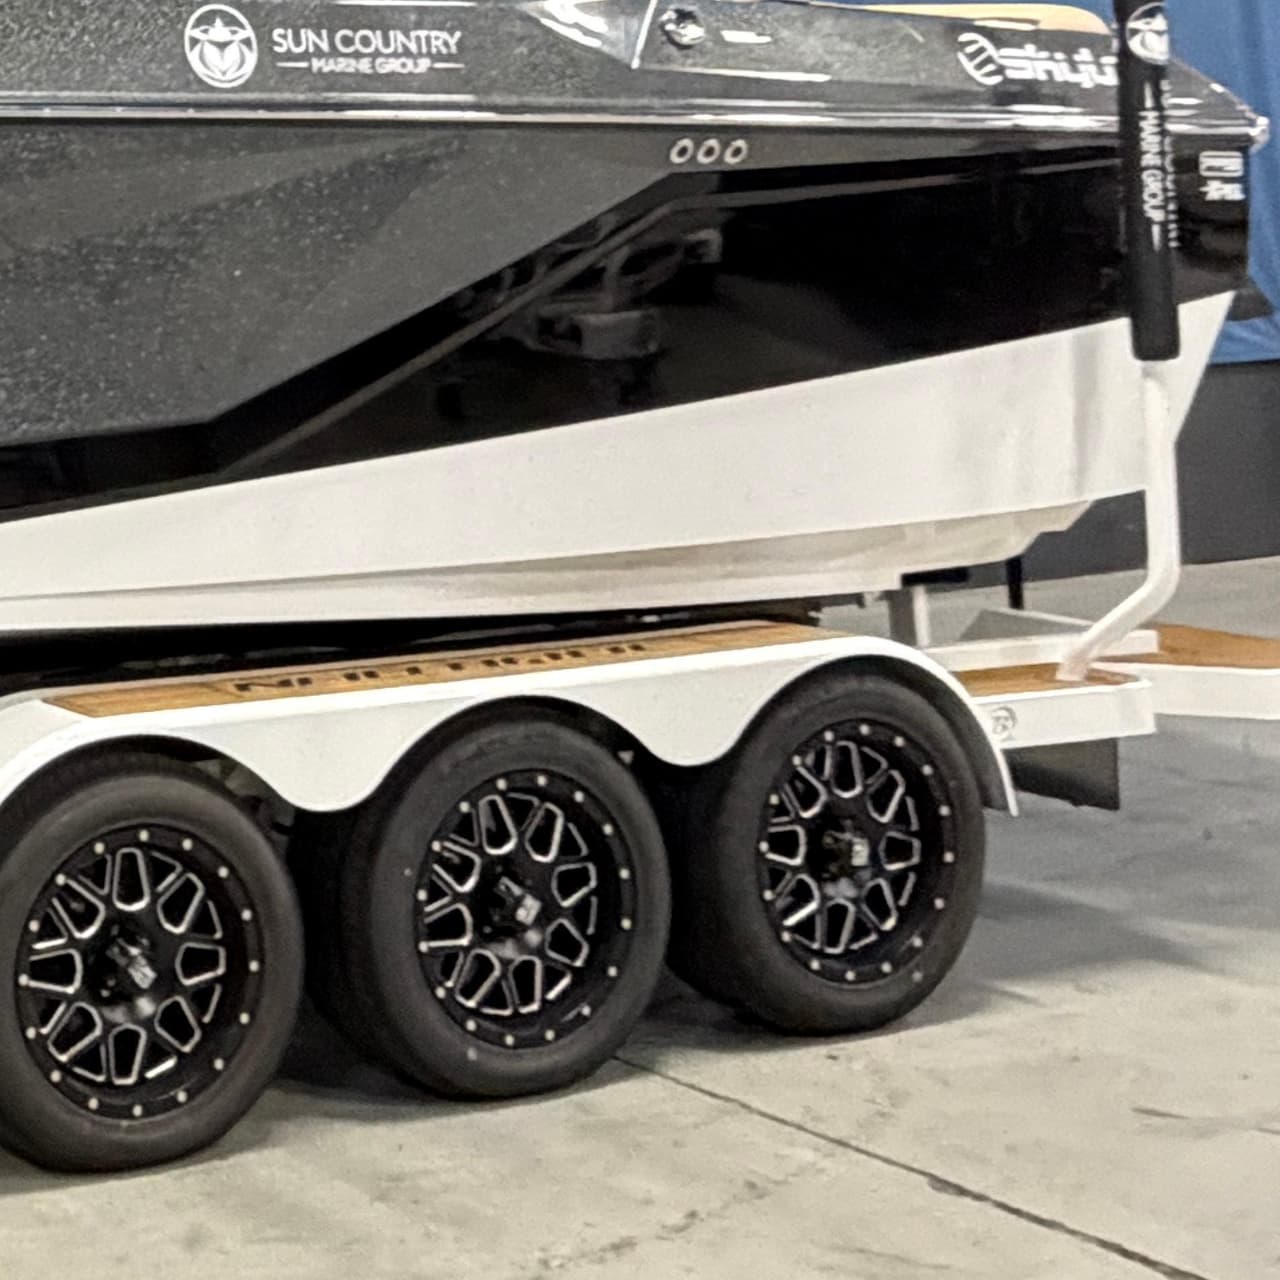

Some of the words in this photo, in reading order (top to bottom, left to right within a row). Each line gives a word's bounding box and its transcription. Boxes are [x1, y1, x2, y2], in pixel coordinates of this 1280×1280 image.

[272, 27, 328, 54] SUN
[334, 28, 462, 55] COUNTRY
[311, 56, 373, 74] MARINE
[374, 57, 433, 74] GROUP
